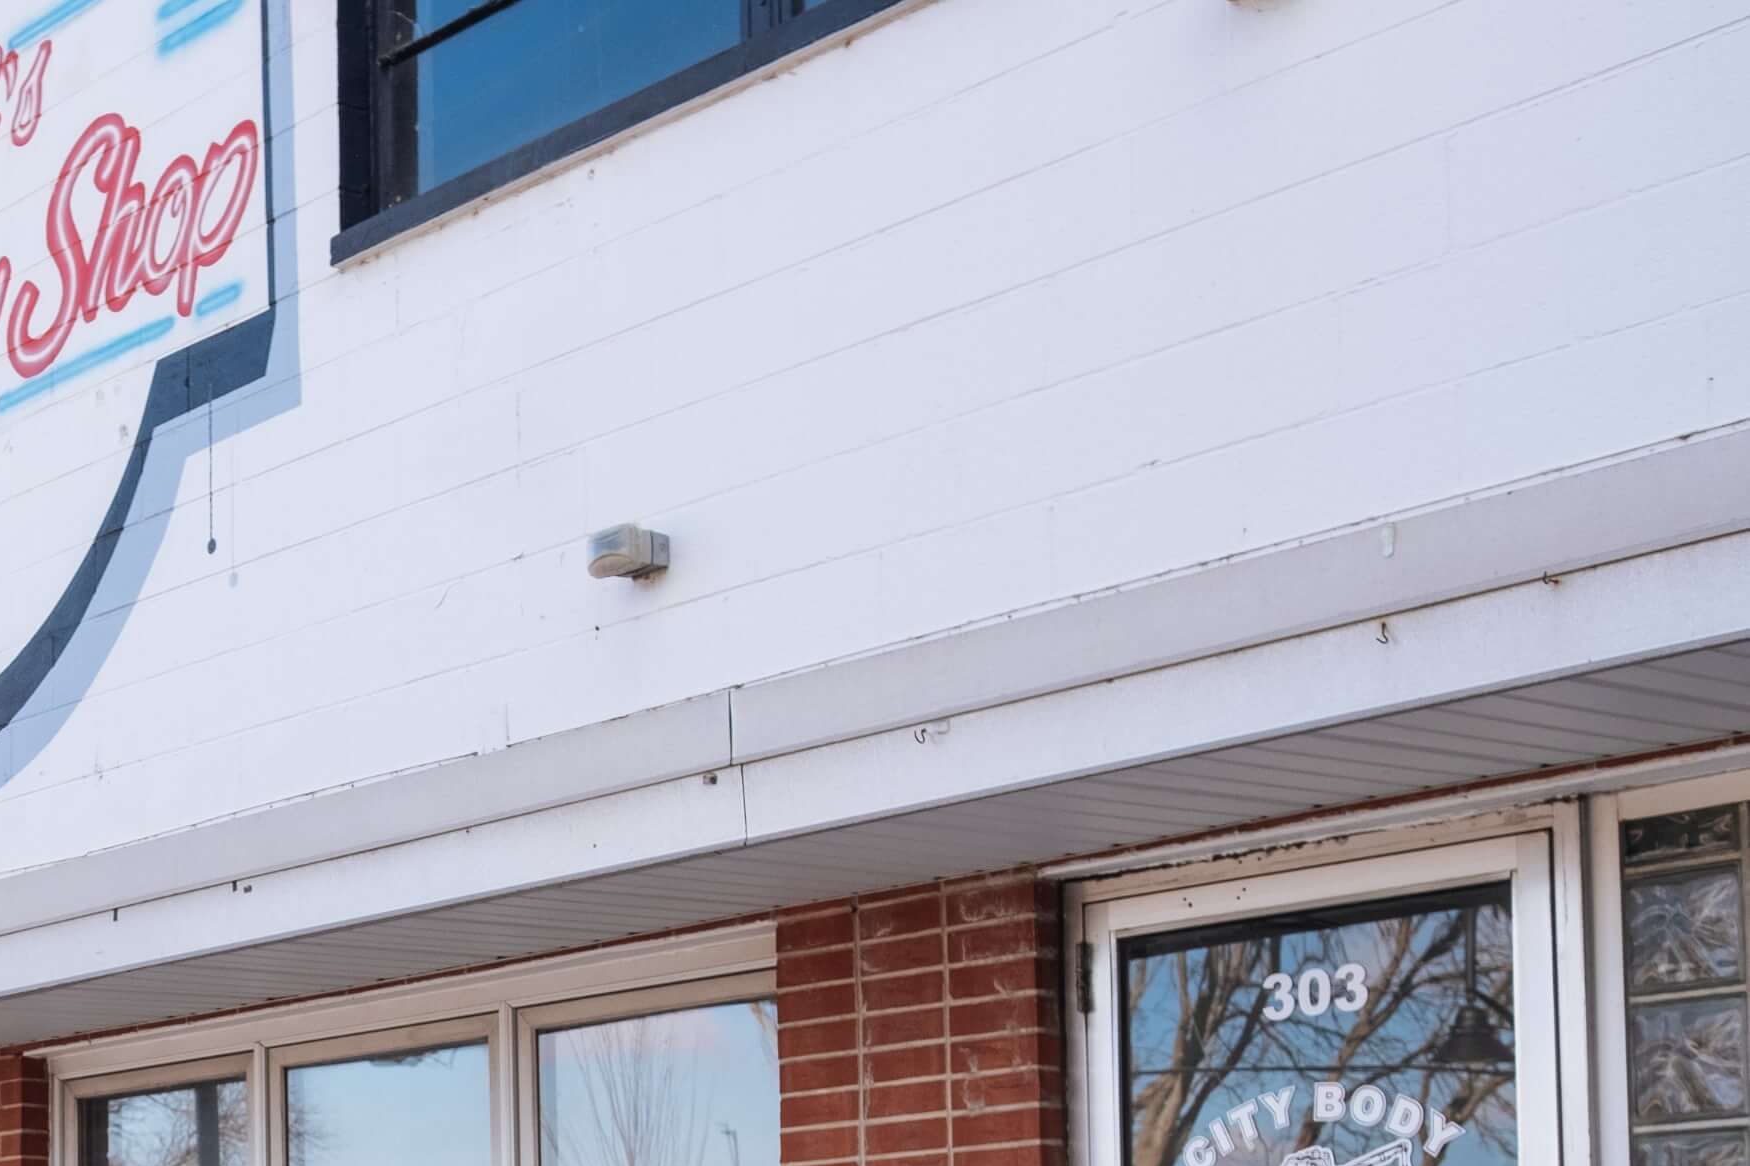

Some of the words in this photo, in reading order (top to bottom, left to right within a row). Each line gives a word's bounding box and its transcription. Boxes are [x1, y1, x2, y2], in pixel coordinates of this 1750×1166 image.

[7, 112, 258, 379] Shop
[1262, 963, 1369, 1022] 303
[1313, 1080, 1467, 1159] BODY
